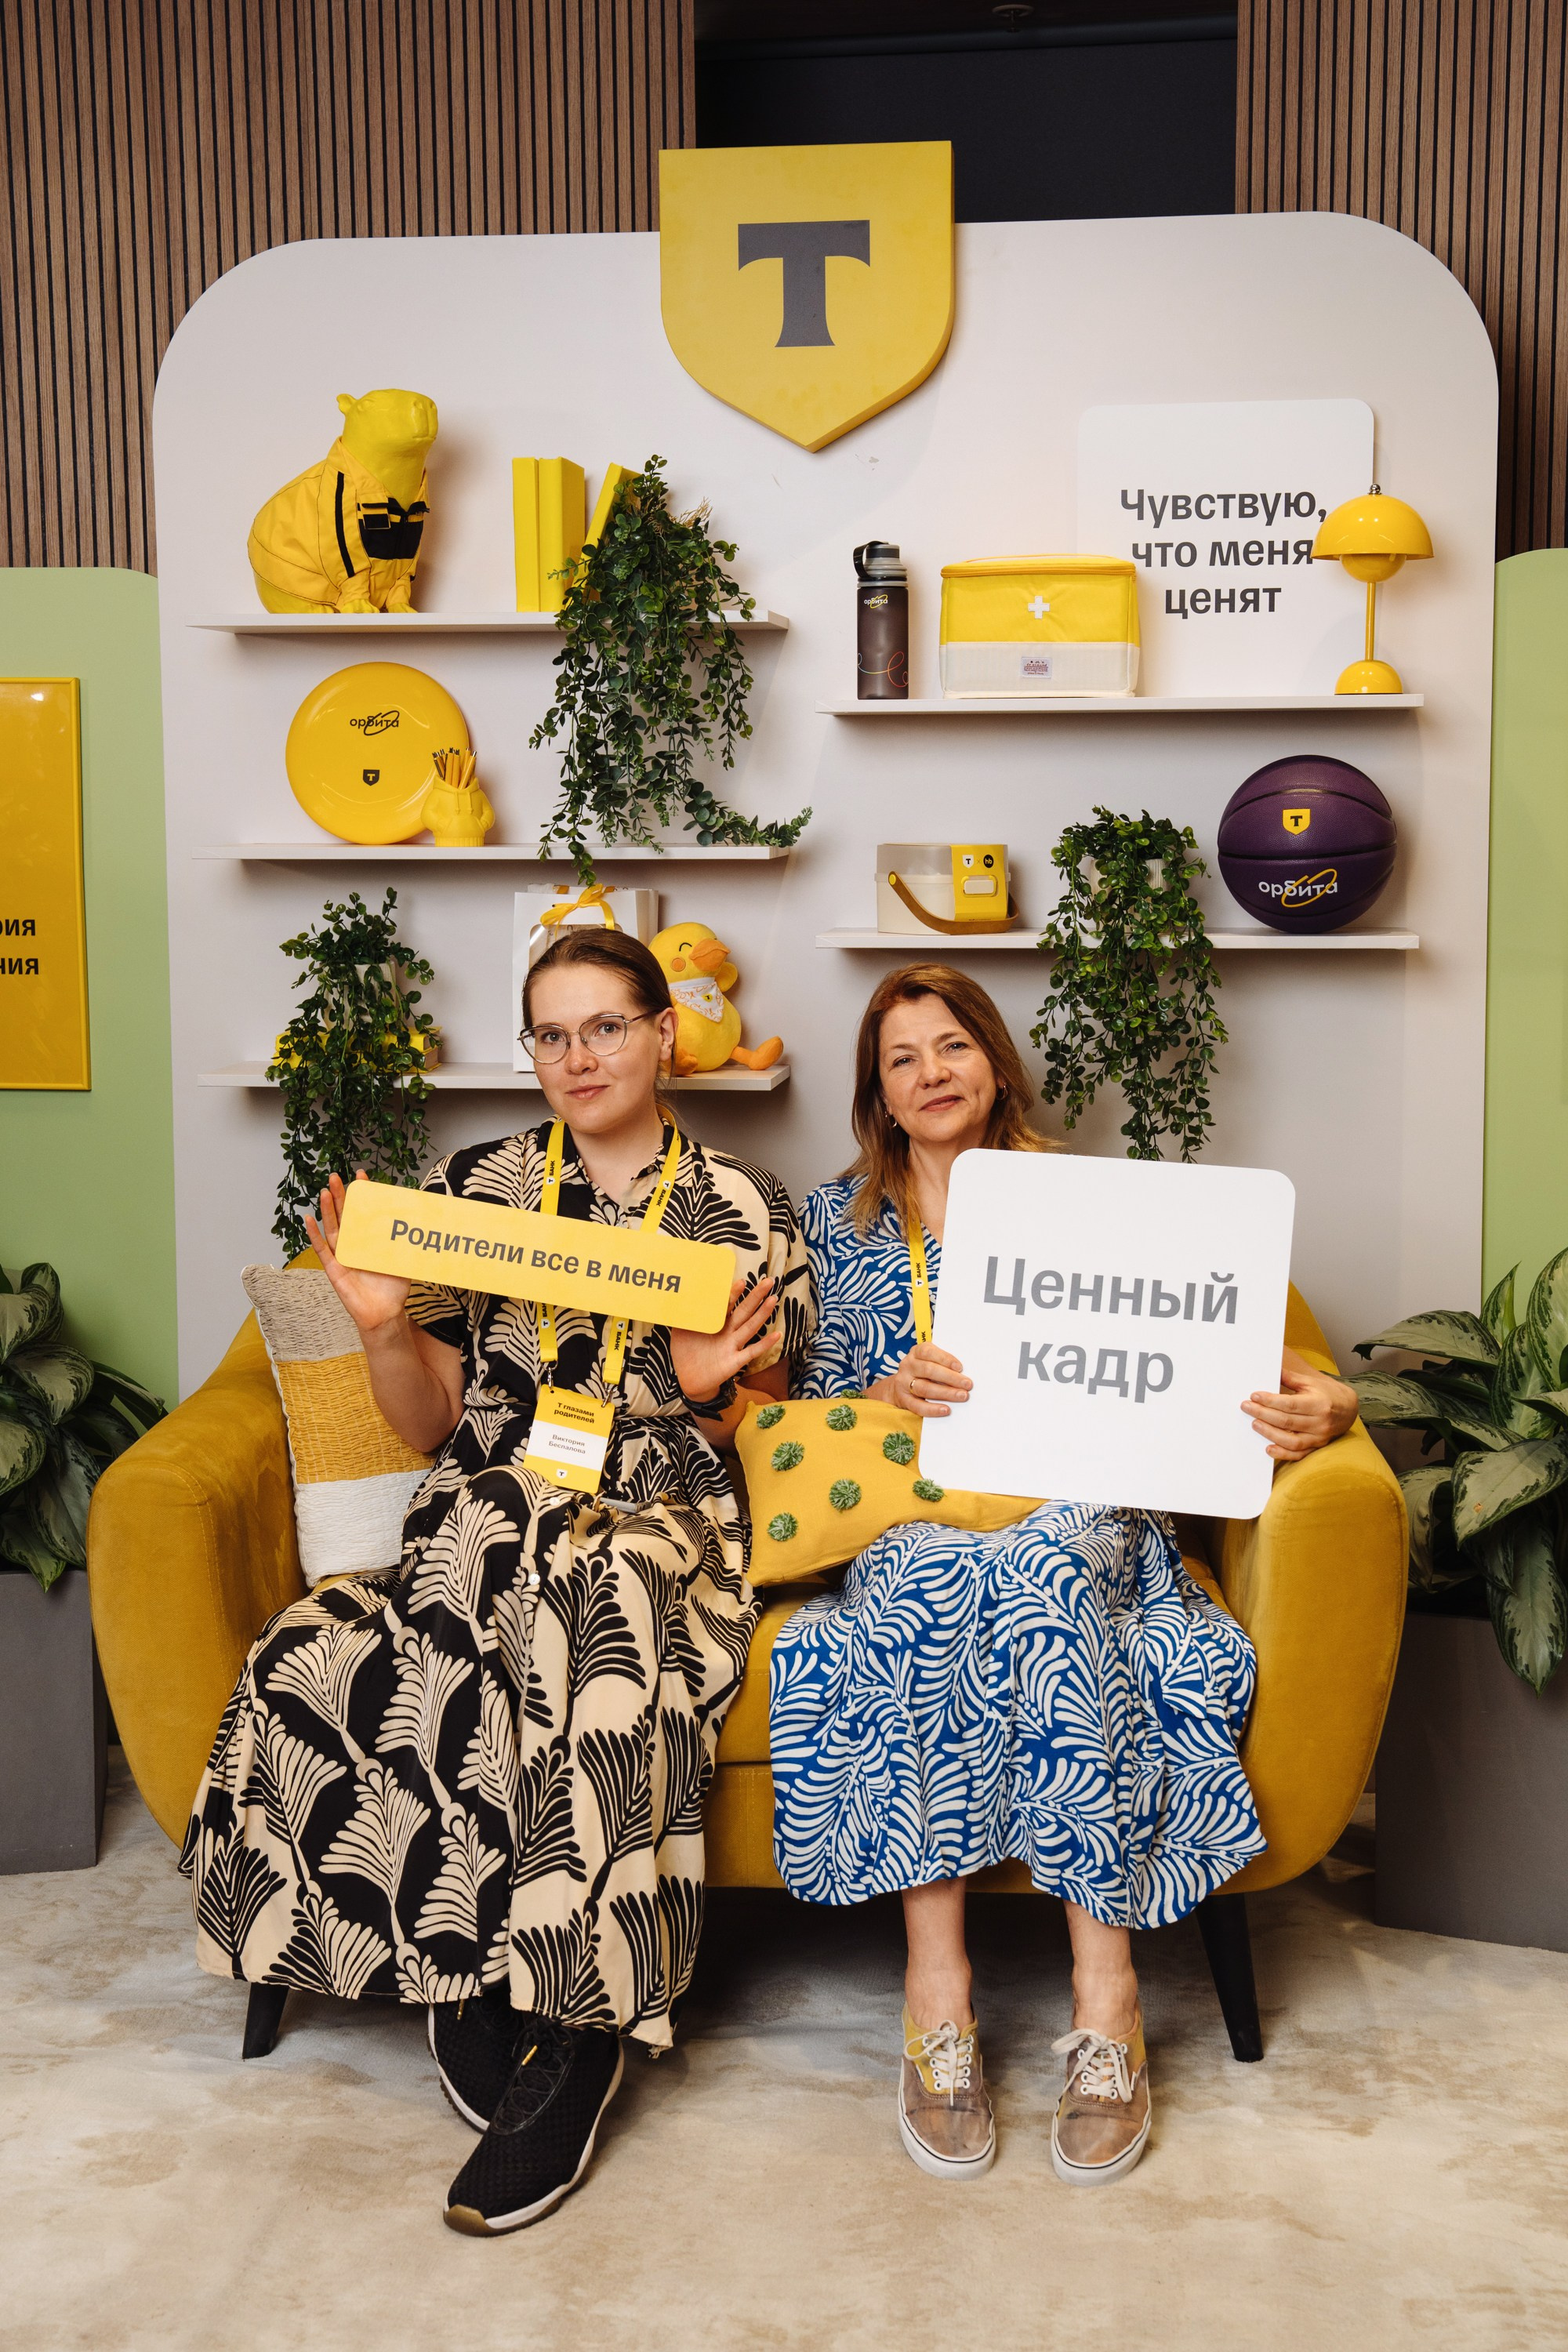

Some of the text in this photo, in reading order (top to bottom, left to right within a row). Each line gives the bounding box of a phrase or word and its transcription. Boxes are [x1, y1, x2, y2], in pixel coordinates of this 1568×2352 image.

[738, 220, 870, 347] Т
[1120, 488, 1327, 529] Чувствую,
[1131, 539, 1314, 568] что меня
[864, 596, 888, 607] орбита
[1164, 587, 1283, 620] ценят
[350, 713, 400, 731] орбита
[1258, 877, 1338, 900] орбита
[0, 919, 36, 936] ия
[655, 1189, 666, 1207] БАНК
[390, 1218, 682, 1294] Родители все в меня
[983, 1255, 1239, 1324] Ценный
[614, 1331, 622, 1351] БАНК
[1017, 1341, 1174, 1404] кадр
[554, 1409, 595, 1424] родителей
[563, 1404, 595, 1417] глазами
[548, 1441, 586, 1454] Беспалова
[552, 1434, 586, 1446] Виктория
